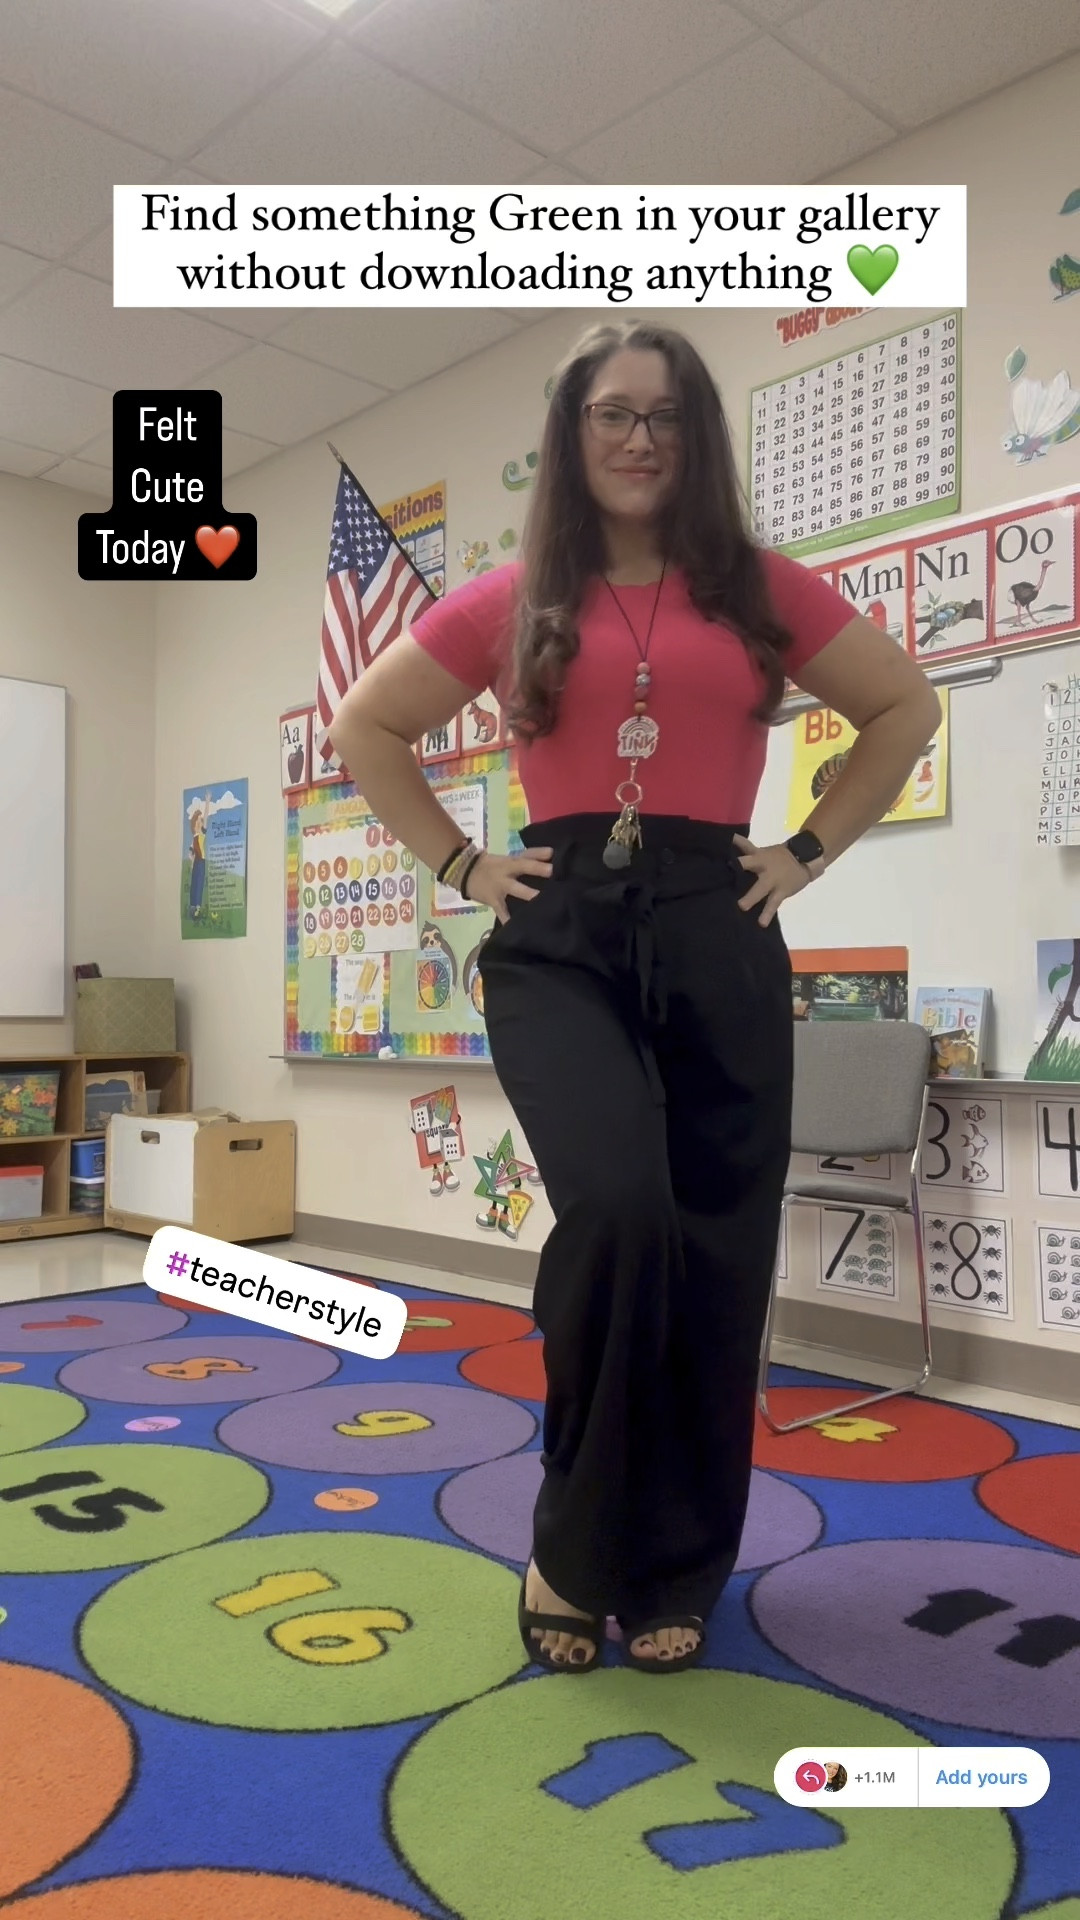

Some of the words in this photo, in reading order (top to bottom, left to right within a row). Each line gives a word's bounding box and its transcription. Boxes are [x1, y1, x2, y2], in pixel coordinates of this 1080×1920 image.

[756, 424, 765, 435] 21
[774, 417, 785, 429] 22
[793, 410, 804, 422] 23
[812, 403, 824, 415] 24
[832, 395, 843, 408] 25
[852, 388, 863, 400] 26
[872, 380, 884, 392] 27
[894, 372, 907, 385] 28
[916, 364, 929, 377] 29
[941, 355, 955, 369] 30
[758, 408, 765, 418] 11
[776, 401, 786, 412] 12
[795, 394, 804, 405] 13
[814, 386, 823, 397] 14
[833, 378, 843, 389] 15
[853, 370, 863, 382] 16
[874, 362, 885, 374] 17
[896, 354, 907, 366] 18
[918, 346, 929, 358] 19
[941, 337, 955, 350] 20
[762, 392, 767, 401] 1
[780, 384, 786, 394] 2
[800, 377, 805, 387] 3
[818, 369, 824, 378] 4
[838, 361, 843, 371] 5
[858, 353, 863, 363] 6
[880, 345, 884, 355] 7
[901, 336, 907, 347] 8
[923, 328, 929, 339] 9
[942, 318, 955, 332] 10
[755, 457, 764, 466] 41
[774, 450, 785, 461] 42
[792, 444, 804, 454] 43
[812, 436, 823, 448] 44
[831, 429, 843, 440] 45
[851, 422, 863, 433] 46
[872, 414, 884, 426] 47
[893, 407, 907, 419] 48
[916, 400, 929, 412] 49
[941, 391, 955, 405] 50
[755, 473, 764, 484] 51
[774, 466, 784, 478] 52
[792, 460, 804, 472] 53
[812, 454, 823, 465] 54
[831, 446, 842, 458] 55
[851, 439, 863, 451] 56
[872, 432, 884, 444] 57
[894, 425, 907, 437] 58
[916, 418, 929, 430] 59
[940, 409, 955, 423] 60
[756, 440, 765, 452] 31
[774, 434, 785, 445] 32
[793, 427, 804, 439] 33
[812, 420, 823, 432] 34
[831, 412, 843, 424] 35
[851, 405, 863, 417] 36
[872, 397, 884, 409] 37
[894, 390, 907, 402] 38
[916, 382, 929, 394] 39
[941, 373, 955, 387] 40
[755, 489, 764, 500] 61
[773, 483, 784, 494] 62
[792, 477, 804, 488] 63
[812, 470, 823, 482] 64
[831, 463, 842, 475] 65
[851, 456, 863, 468] 66
[872, 449, 884, 461] 67
[894, 442, 907, 455] 68
[916, 436, 929, 448] 69
[942, 427, 954, 440] 70
[840, 564, 904, 601] Mm
[915, 546, 970, 587] Nn
[995, 524, 1054, 564] Oo
[805, 708, 843, 744] Bb
[1063, 689, 1072, 705] 2
[281, 723, 300, 748] Aa
[305, 893, 313, 903] 11
[320, 889, 330, 901] 12
[335, 887, 345, 898] 13
[350, 884, 360, 897] 14
[367, 884, 378, 897] 15
[384, 884, 394, 895] 16
[401, 878, 411, 891] 17
[337, 861, 343, 872] 6
[402, 853, 412, 865] 10
[305, 918, 314, 929] 18
[320, 911, 330, 923] 19
[335, 913, 346, 924] 20
[352, 911, 361, 922] 21
[368, 910, 379, 921] 22
[384, 910, 395, 921] 23
[401, 904, 412, 917] 24
[351, 934, 363, 947] 28
[923, 1007, 977, 1029] Bible
[926, 1101, 951, 1180] 3
[1043, 1106, 1080, 1192] 4
[824, 1207, 866, 1280] 7
[949, 1221, 982, 1301] 8
[142, 1356, 258, 1381] 8
[334, 1409, 435, 1438] 9
[0, 1470, 165, 1534] 15
[211, 1567, 414, 1666] 16
[538, 1731, 847, 1873] 17
